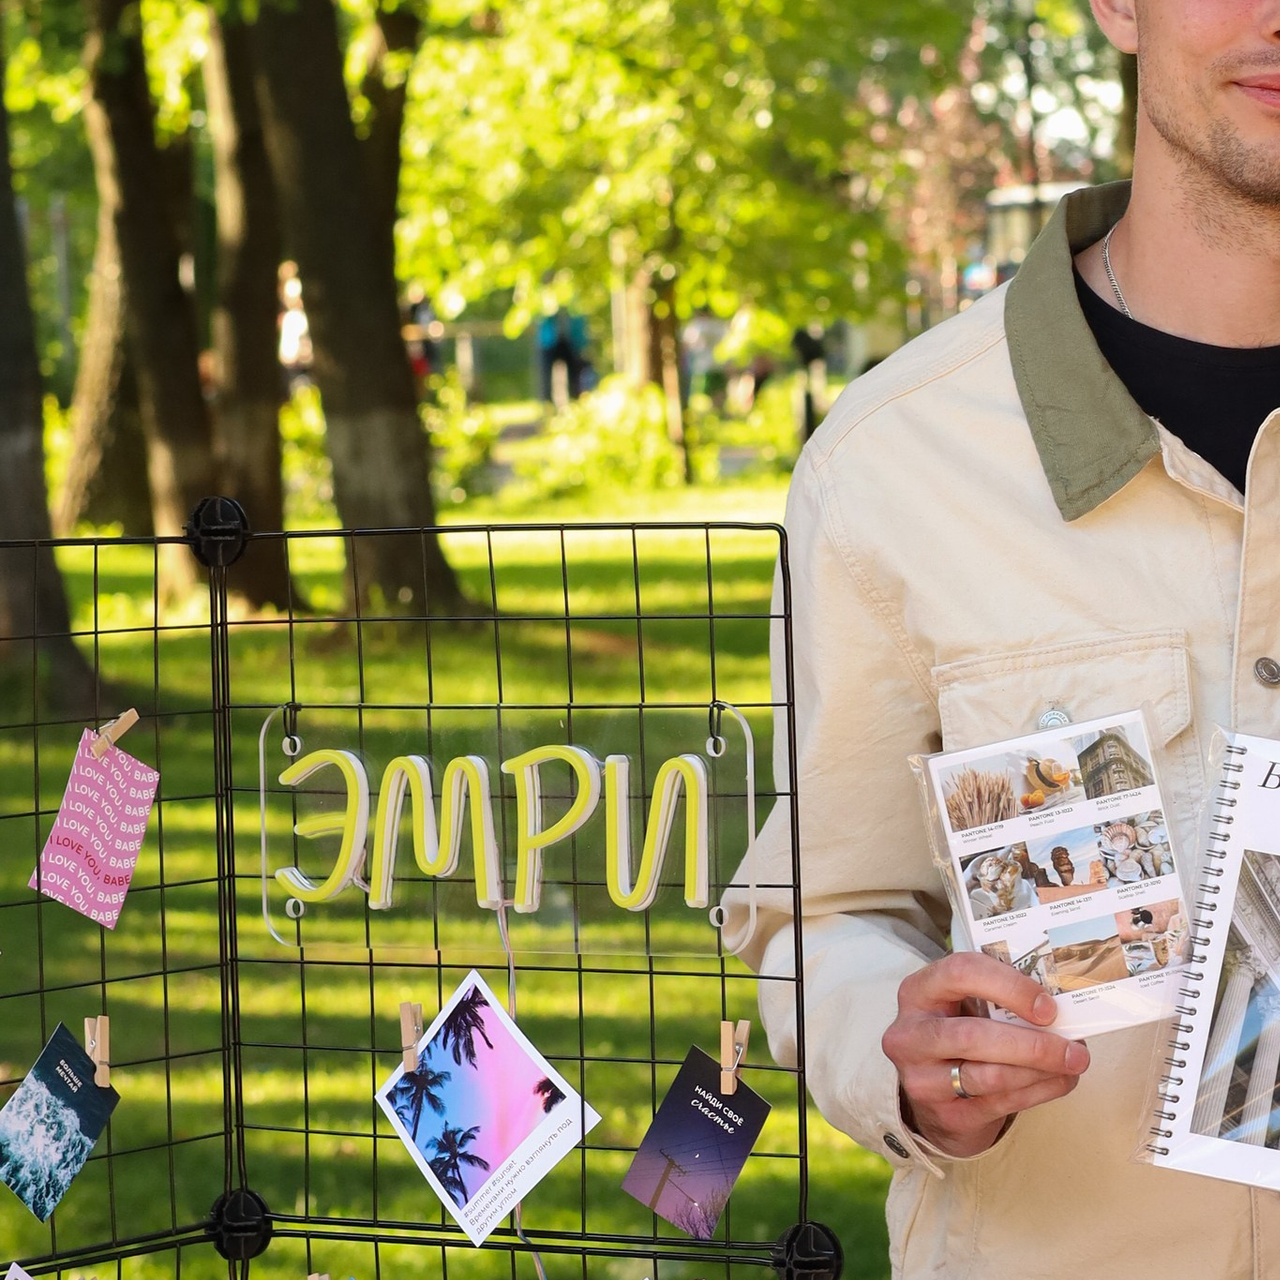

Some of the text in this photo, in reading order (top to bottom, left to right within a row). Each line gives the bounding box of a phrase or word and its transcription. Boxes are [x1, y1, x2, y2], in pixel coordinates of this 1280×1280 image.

[75, 782, 146, 835] LOVE YOU, BABE
[80, 765, 151, 817] LOVE YOU, BABE
[129, 787, 155, 800] BABE
[1096, 794, 1121, 806] PANTONE
[69, 799, 141, 852] LOVE YOU, BABE
[275, 744, 708, 914] ЭМРИ
[961, 826, 987, 838] PANTONE
[1028, 810, 1054, 822] PANTONE
[56, 834, 84, 856] LOVE
[83, 851, 101, 880] YOU,
[103, 874, 130, 887] BABE
[63, 817, 136, 869] LOVE YOU, BABE
[41, 870, 70, 890] LOVE
[90, 908, 119, 922] BABE
[49, 853, 125, 904] LOVE YOU, BABE
[1116, 883, 1143, 895] PANTONE
[983, 916, 1008, 927] PANTONE
[1050, 899, 1075, 911] PANTONE
[55, 1066, 79, 1094] МЕЧТАЙ
[59, 1059, 83, 1088] БОЛЬШЕ
[690, 1099, 735, 1134] счастье
[694, 1085, 723, 1110] НАЙДИ
[463, 1159, 517, 1219] #summer #sunset
[469, 1118, 573, 1226] Временами нужно взглянуть под
[476, 1187, 518, 1235] другим углом
